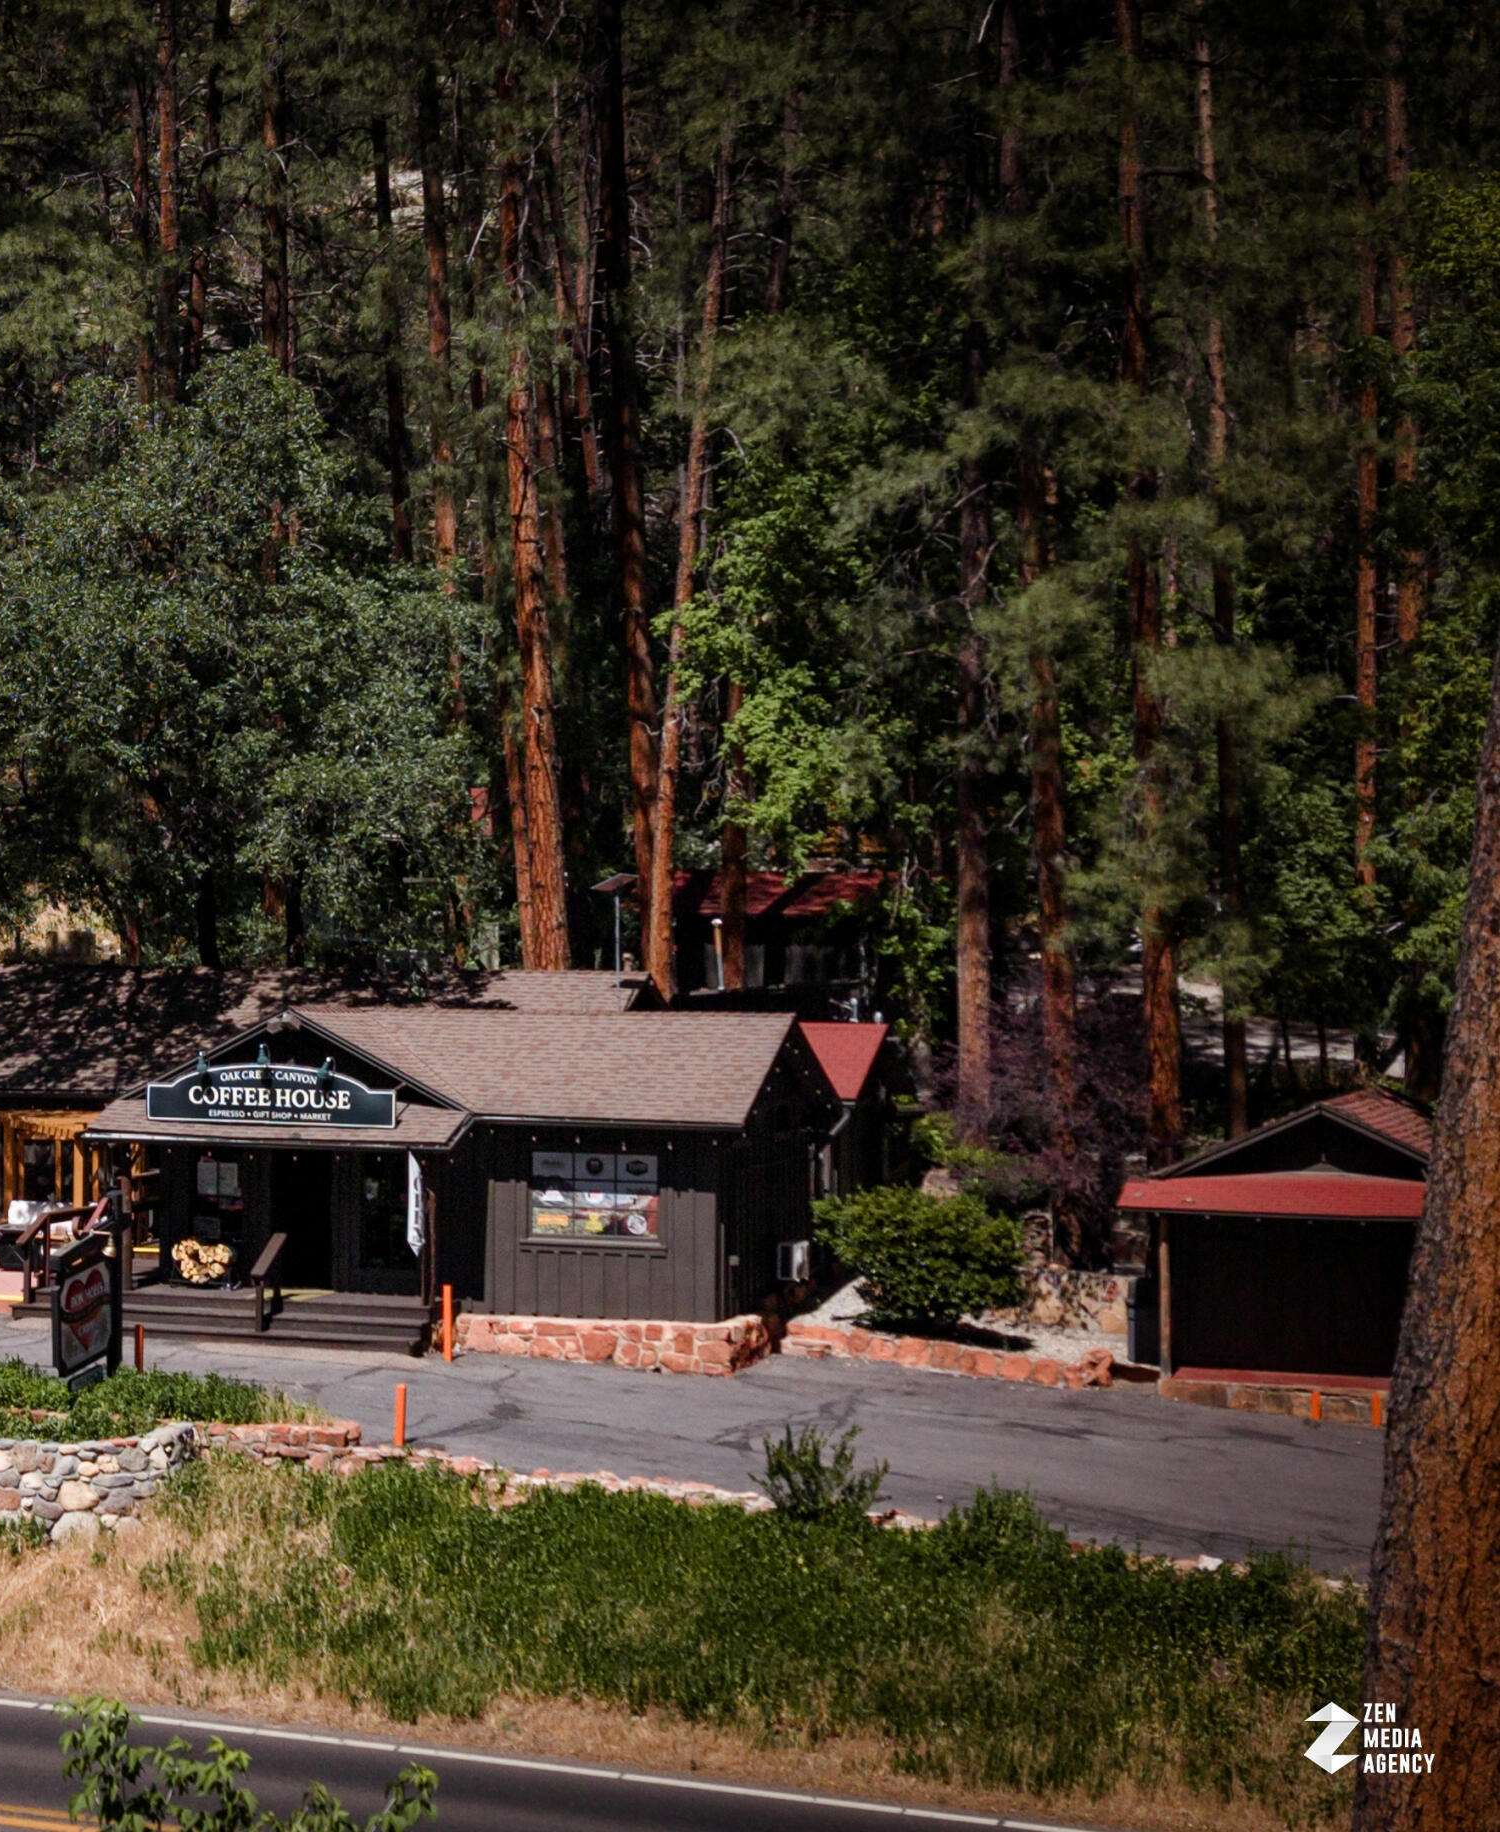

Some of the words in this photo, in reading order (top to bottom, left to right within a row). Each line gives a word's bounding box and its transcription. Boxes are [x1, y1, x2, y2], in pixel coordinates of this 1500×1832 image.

[219, 1071, 240, 1082] OAK
[241, 1070, 275, 1081] CRE
[274, 1070, 318, 1085] CANYON
[188, 1085, 272, 1107] COFFEE
[275, 1087, 351, 1110] HOUSE
[208, 1109, 246, 1118] ESPRESSO
[252, 1110, 270, 1119] GIFT
[271, 1110, 293, 1120] SHOP
[299, 1112, 332, 1121] MARKET
